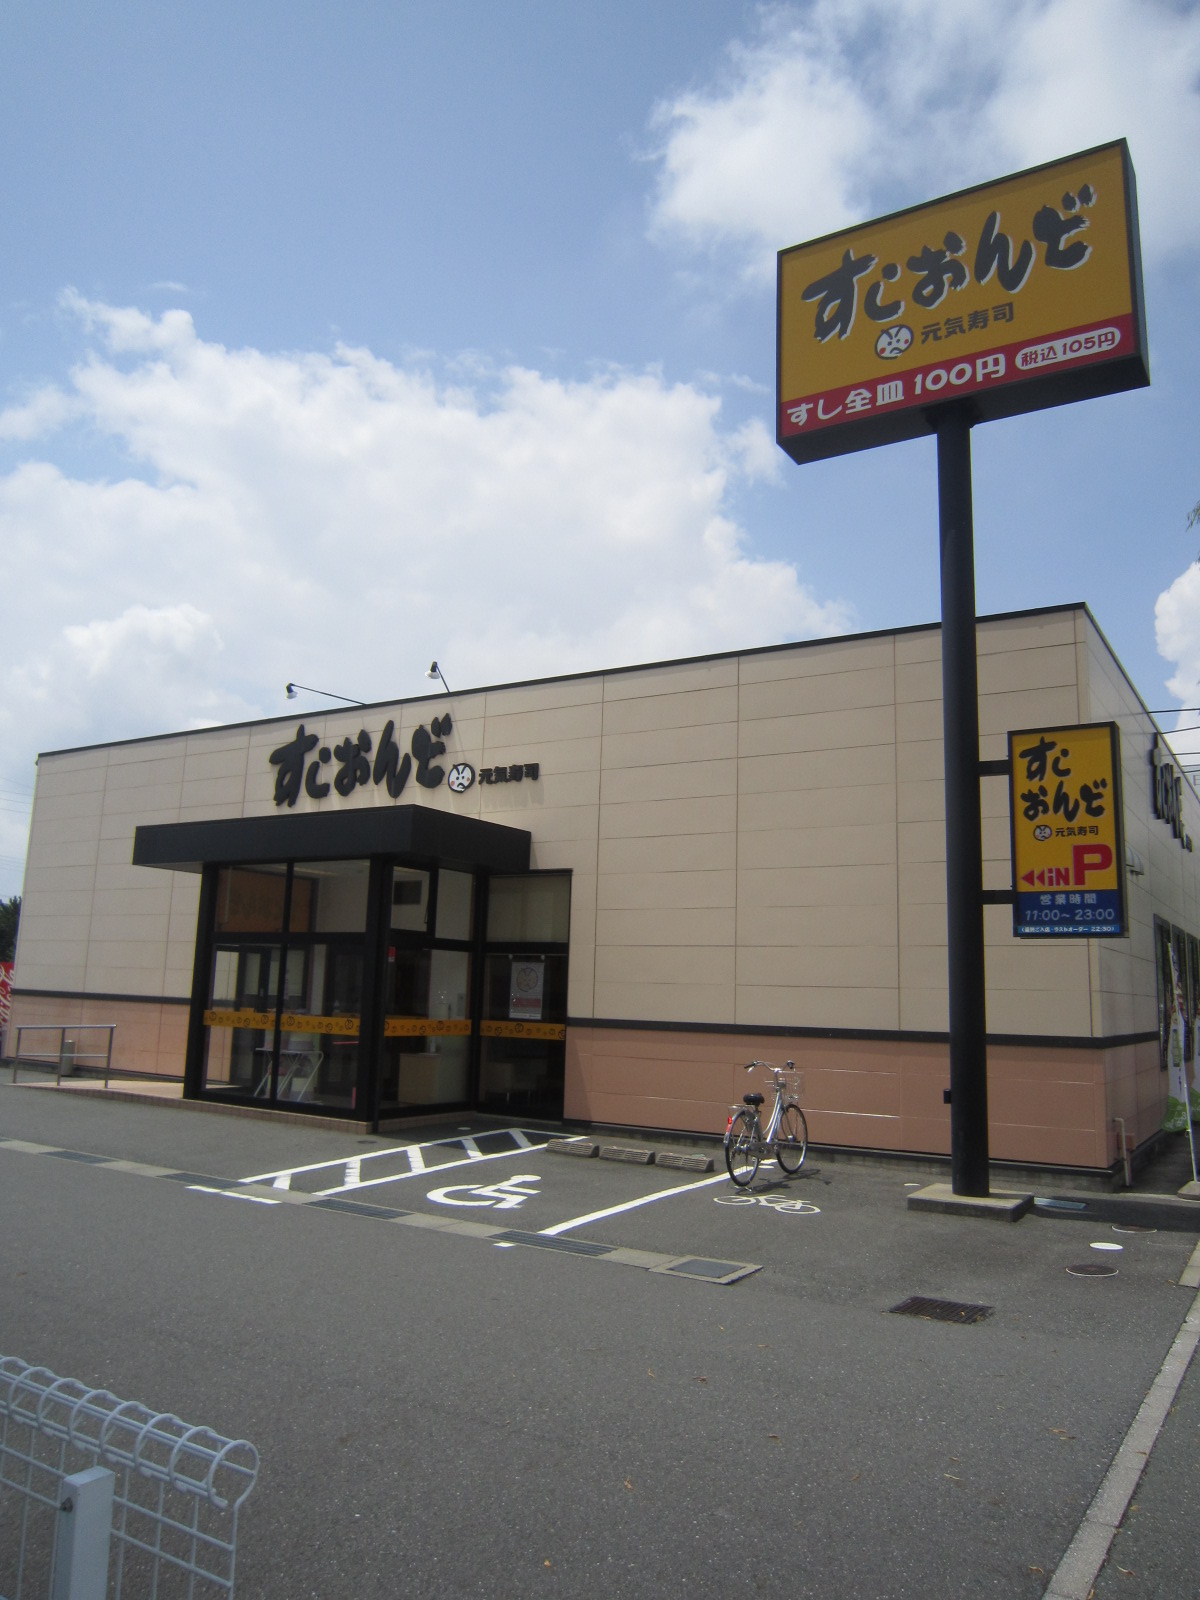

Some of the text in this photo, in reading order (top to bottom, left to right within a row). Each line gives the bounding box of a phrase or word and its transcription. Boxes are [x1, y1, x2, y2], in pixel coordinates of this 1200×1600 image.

[920, 302, 1014, 344] 元気寿司
[478, 763, 540, 785] 元気寿司
[1020, 777, 1107, 822] おんど
[1055, 825, 1099, 837] 元気寿司
[1073, 844, 1113, 886] P
[1040, 893, 1097, 905] 営業時間
